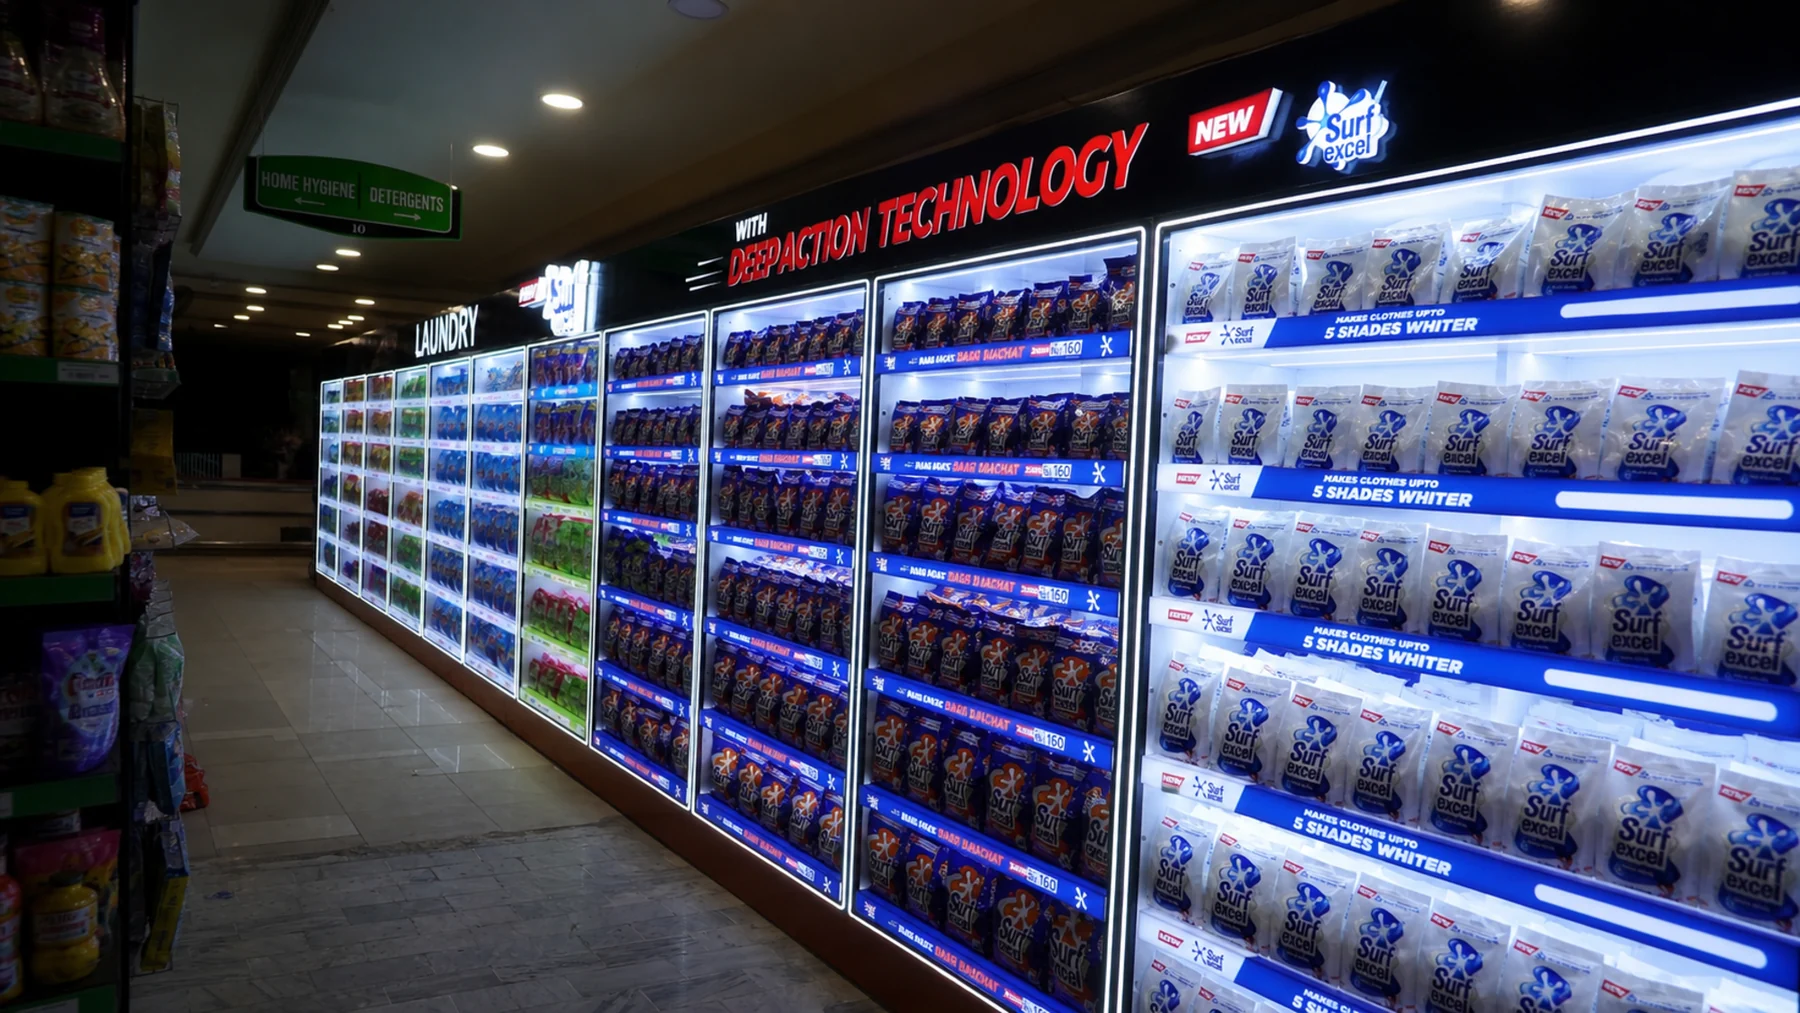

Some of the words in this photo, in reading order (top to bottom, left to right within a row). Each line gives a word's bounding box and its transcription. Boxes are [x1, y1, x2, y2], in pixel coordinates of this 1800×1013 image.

[1195, 105, 1254, 145] NEW
[1326, 105, 1374, 143] Surf
[1324, 135, 1370, 161] excel
[261, 171, 299, 191] HOME
[303, 177, 355, 199] HYGIENE
[878, 122, 1149, 247] TECHNOLOGY
[370, 187, 444, 213] DETERGENTS
[352, 224, 366, 234] 10
[735, 212, 767, 241] WITH
[1552, 250, 1589, 266] Surf
[1648, 240, 1684, 257] Surf
[1747, 249, 1796, 267] excel
[1460, 257, 1497, 278] Surf
[1548, 264, 1584, 279] excel
[1641, 255, 1681, 271] excel
[1336, 314, 1368, 324] MAKES
[1370, 311, 1413, 321] CLOTHES
[1416, 309, 1445, 318] UPTO
[415, 304, 479, 358] LAUNDRY
[1324, 326, 1335, 339] 5
[1337, 323, 1401, 337] SHADES
[1406, 318, 1478, 333] WHITER
[1063, 342, 1081, 355] 160
[1365, 435, 1395, 449] Surf
[1446, 435, 1481, 452] Surf
[1532, 433, 1573, 449] Surf
[1629, 433, 1675, 450] Surf
[1746, 435, 1798, 455] Surf
[1626, 451, 1667, 466] excel
[1742, 455, 1789, 470] excel
[1053, 465, 1070, 477] 160
[1323, 475, 1358, 484] MAKES
[1360, 477, 1406, 486] CLOTHES
[1409, 479, 1438, 488] UPTO
[1312, 486, 1322, 497] 5
[1326, 486, 1393, 503] SHADES
[1398, 490, 1473, 507] WHITER
[1174, 550, 1202, 568] Surf
[1234, 559, 1265, 579] Surf
[1231, 578, 1262, 593] excel
[1298, 566, 1333, 588] Surf
[1364, 577, 1401, 598] Surf
[1050, 588, 1068, 603] 160
[1295, 586, 1328, 602] excel
[1434, 589, 1475, 611] Surf
[1361, 597, 1397, 615] excel
[1517, 600, 1561, 624] Surf
[1432, 610, 1469, 627] excel
[1613, 608, 1662, 633] Surf
[1314, 626, 1348, 638] MAKES
[1350, 632, 1396, 645] CLOTHES
[1399, 640, 1430, 652] UPTO
[1516, 623, 1556, 639] excel
[1612, 633, 1659, 650] excel
[1727, 626, 1785, 652] Surf
[1303, 636, 1313, 648] 5
[1317, 639, 1383, 660] SHADES
[1388, 650, 1463, 674] WHITER
[1725, 651, 1779, 672] excel
[1054, 681, 1080, 699] Surf
[1165, 703, 1194, 725] Surf
[1046, 732, 1064, 749] 160
[1225, 723, 1260, 745] Surf
[1222, 742, 1255, 759] excel
[1290, 742, 1327, 766] Surf
[1287, 761, 1322, 781] excel
[1360, 758, 1397, 782] Surf
[1357, 778, 1392, 798] excel
[1439, 775, 1480, 803] Surf
[1437, 794, 1474, 818] excel
[1524, 795, 1571, 825] Surf
[1304, 809, 1338, 825] MAKES
[1340, 819, 1386, 839] CLOTHES
[1388, 834, 1418, 849] UPTO
[1522, 818, 1563, 840] excel
[1619, 818, 1672, 850] Surf
[1293, 817, 1304, 829] 5
[1306, 821, 1373, 851] SHADES
[1377, 842, 1452, 876] WHITER
[1616, 841, 1664, 866] excel
[1158, 858, 1186, 884] Surf
[1728, 849, 1786, 885] Surf
[1039, 874, 1057, 892] 160
[1156, 878, 1183, 897] excel
[1726, 874, 1781, 901] excel
[1217, 881, 1252, 907] Surf
[1215, 903, 1249, 922] excel
[1285, 910, 1321, 938] Surf
[1051, 928, 1088, 960] Surf
[1282, 931, 1316, 952] excel
[1357, 937, 1396, 965] Surf
[1355, 960, 1390, 980] excel
[1433, 967, 1473, 998] Surf
[1292, 995, 1303, 1008] 5
[1303, 989, 1338, 1010] MAKES
